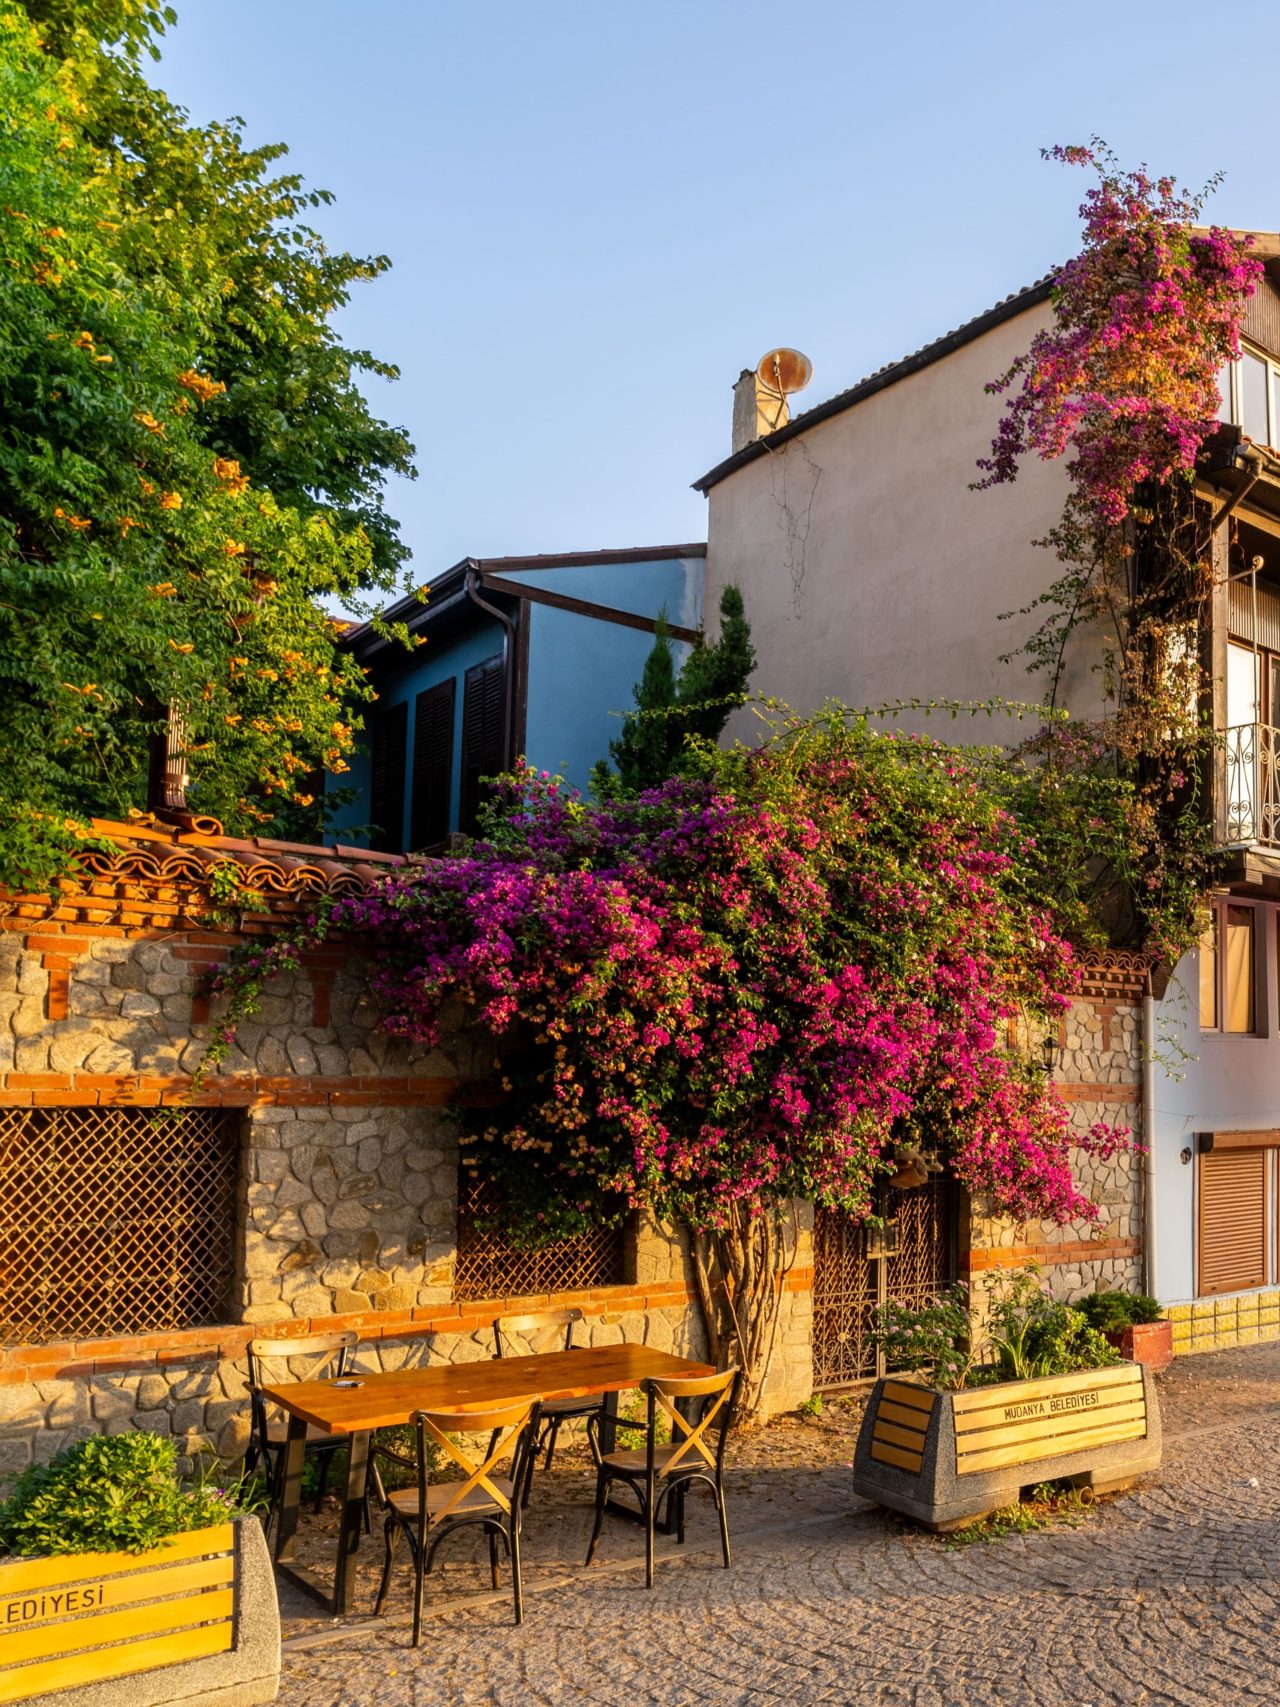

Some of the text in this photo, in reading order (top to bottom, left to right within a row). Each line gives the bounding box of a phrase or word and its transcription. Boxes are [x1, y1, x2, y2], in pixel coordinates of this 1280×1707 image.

[1004, 1392, 1099, 1420] MUDANYA BELEDİYESİ
[0, 1585, 103, 1624] EDİYESİ
